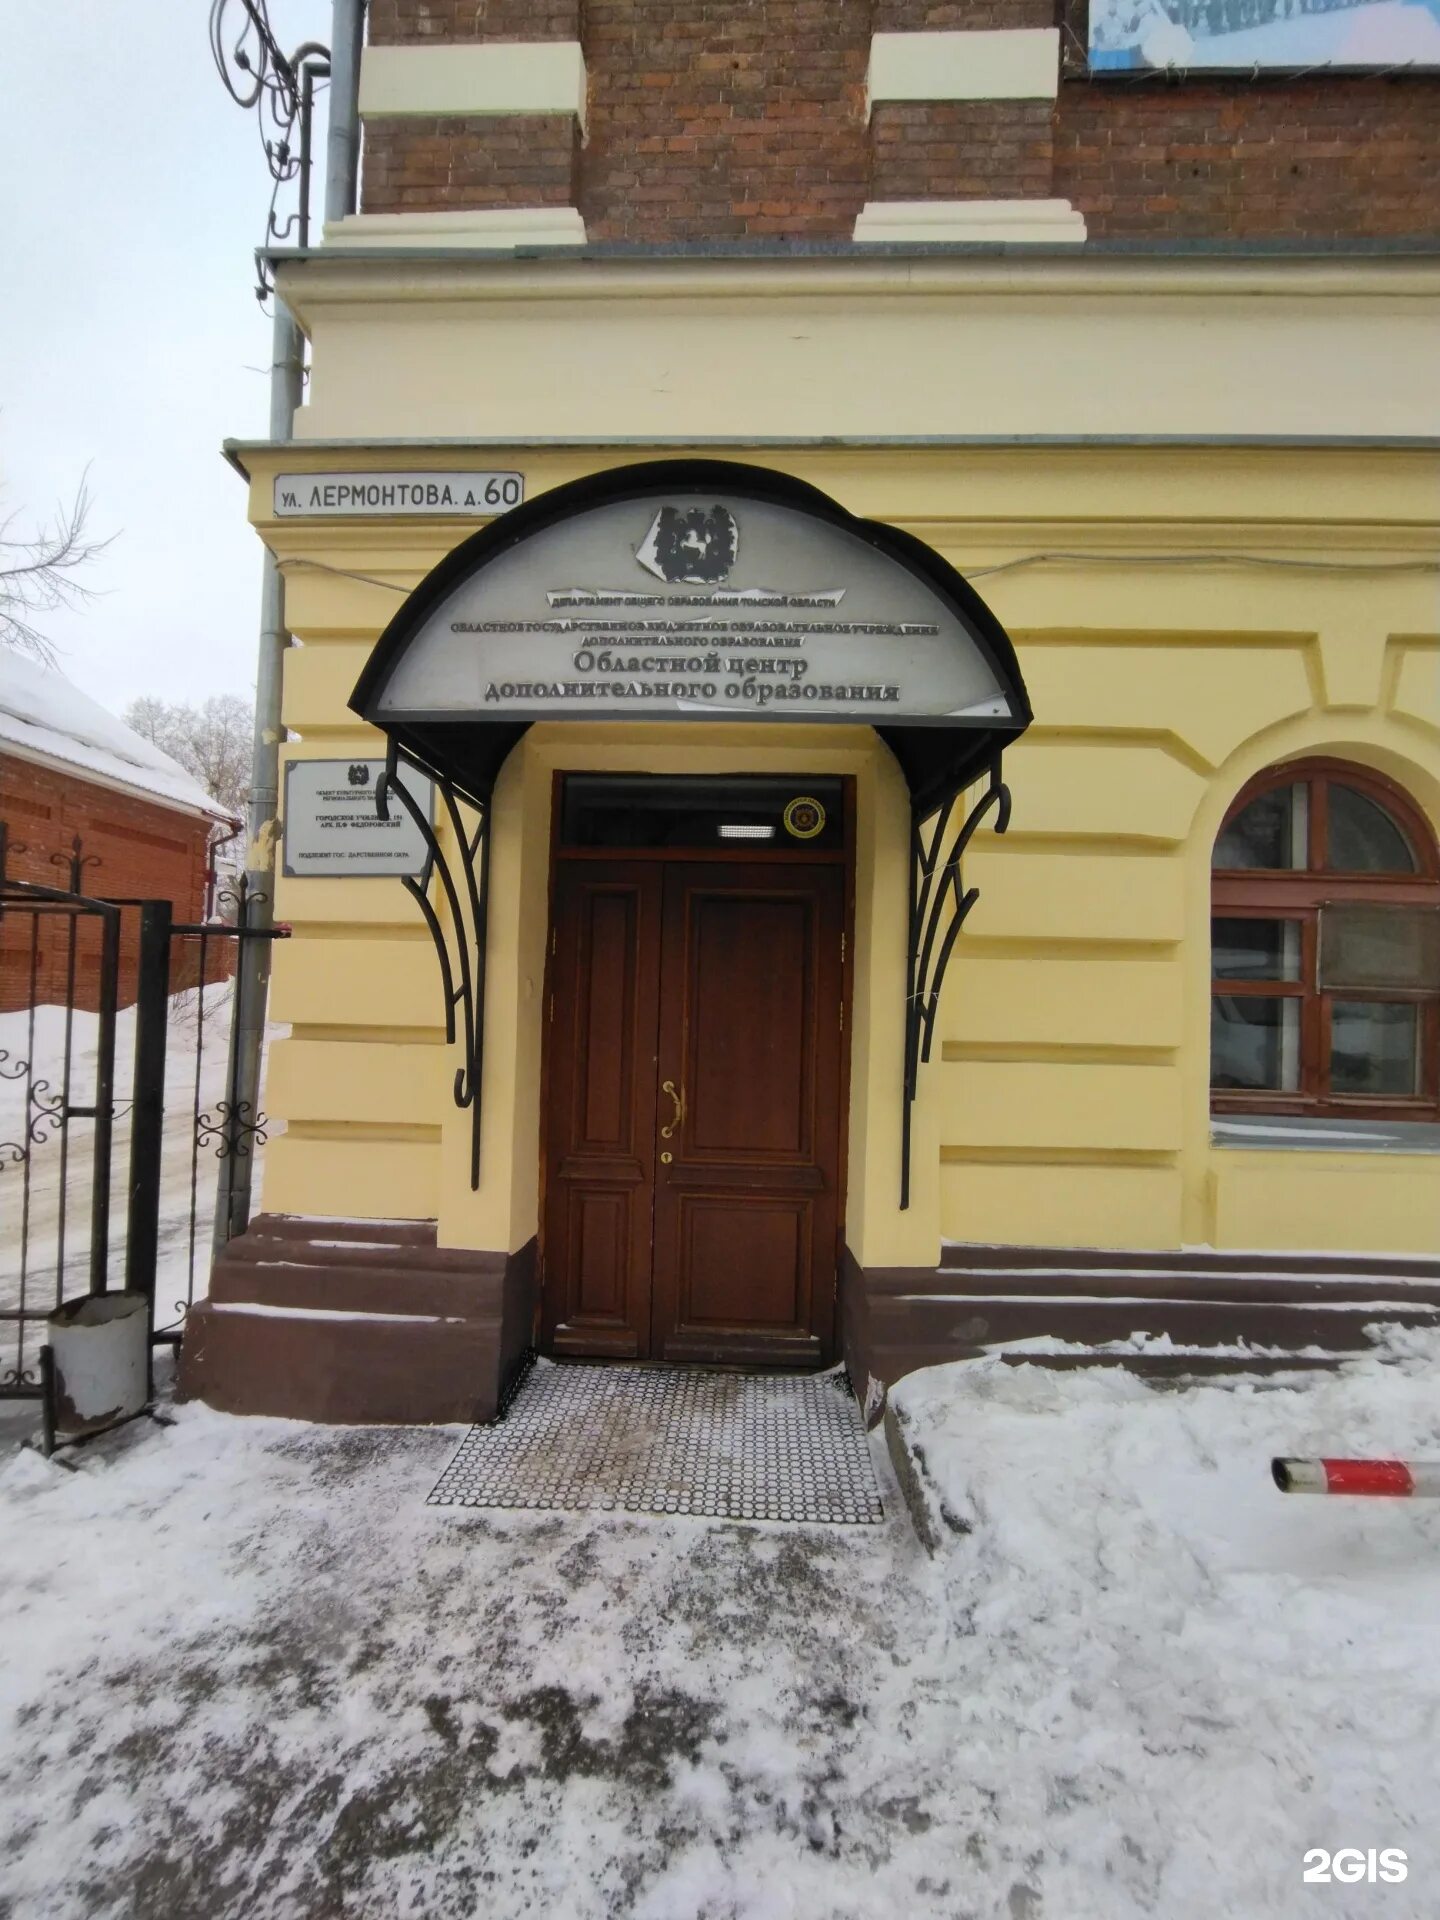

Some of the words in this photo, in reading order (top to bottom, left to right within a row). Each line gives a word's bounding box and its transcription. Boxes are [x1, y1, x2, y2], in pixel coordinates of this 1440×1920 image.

[450, 623, 525, 633] ОБЛАСТНОЕ
[525, 622, 644, 634] ГОСУДАРСТВЕННОЕ
[730, 622, 850, 634] ОБРАЗОВАТЕЛЬНОЕ
[582, 636, 709, 648] ДОПОЛНИТЕЛЬНОГО
[711, 636, 801, 648] ОБРАЗОВАНИЯ
[574, 651, 721, 674] Областной
[727, 658, 808, 681] центр
[724, 677, 900, 705] образования
